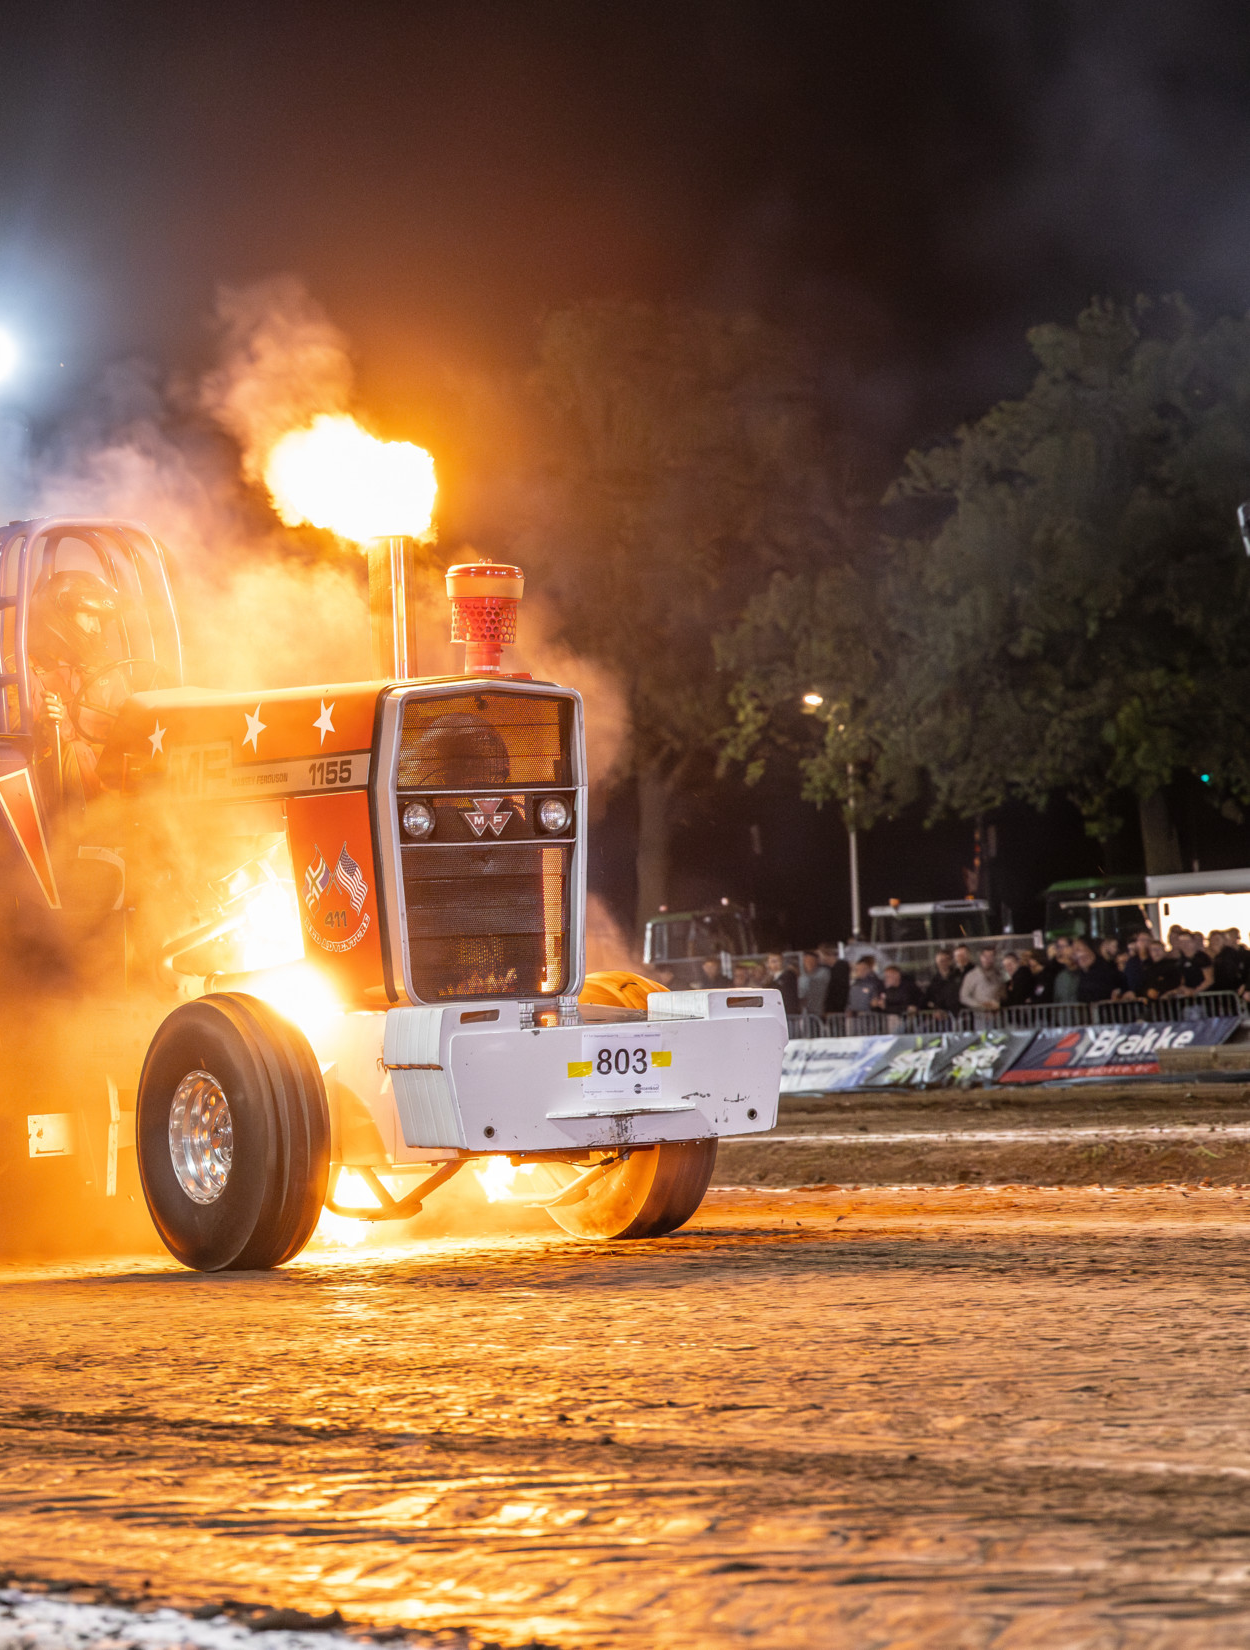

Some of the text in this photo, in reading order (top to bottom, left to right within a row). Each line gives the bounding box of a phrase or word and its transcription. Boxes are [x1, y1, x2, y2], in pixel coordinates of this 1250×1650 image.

[256, 772, 289, 785] FERGUSON
[308, 759, 352, 786] 1155
[321, 912, 371, 953] ADVENTURE
[324, 910, 348, 928] 411
[1085, 1025, 1195, 1058] Brakke
[596, 1048, 648, 1075] 803
